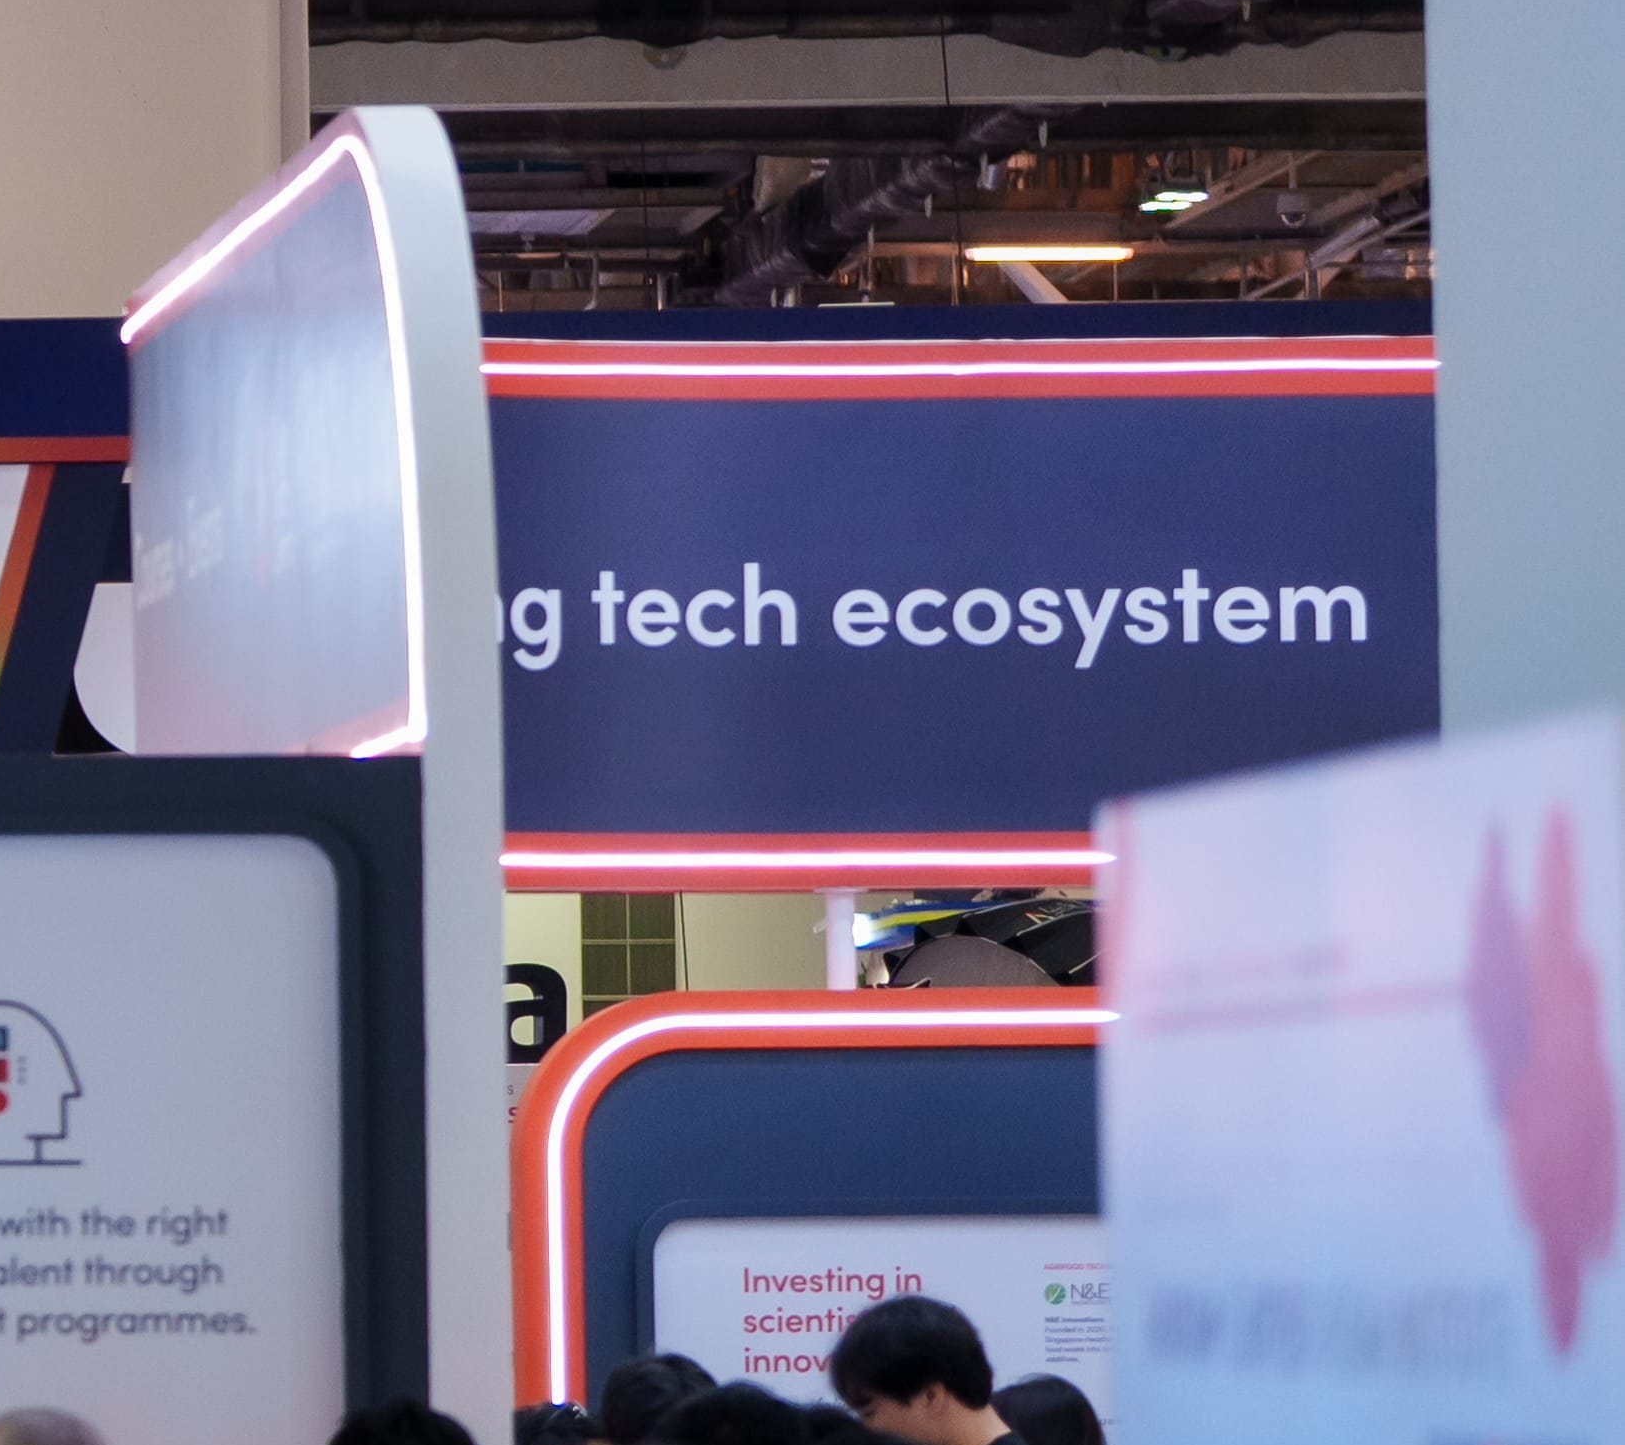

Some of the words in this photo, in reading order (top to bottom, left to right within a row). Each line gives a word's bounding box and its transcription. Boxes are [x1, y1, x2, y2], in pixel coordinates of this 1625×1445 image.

[590, 561, 800, 648] tech
[831, 568, 1369, 670] ecosystem
[81, 1207, 135, 1238] the
[145, 1206, 228, 1246] right
[83, 1256, 223, 1294] through
[743, 1266, 885, 1300] Investing
[895, 1266, 922, 1293] in
[16, 1308, 255, 1342] programmes.
[743, 1306, 861, 1333] scientis
[743, 1347, 833, 1374] innov
